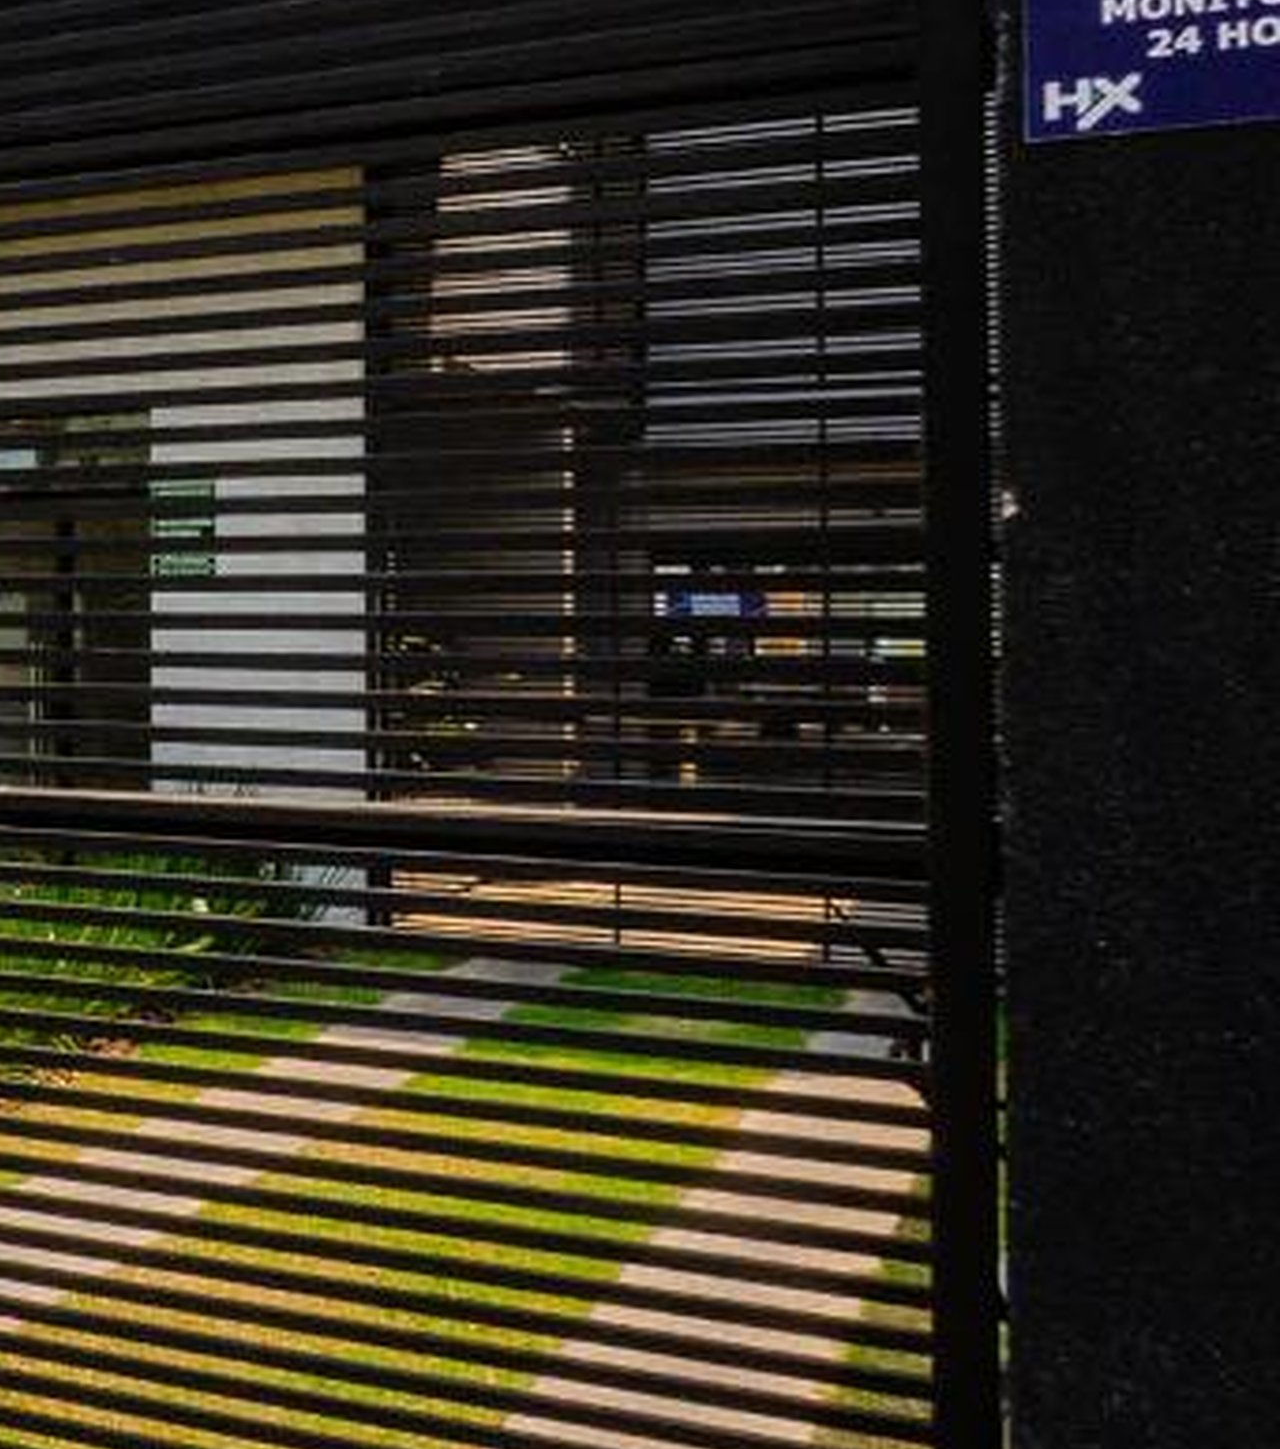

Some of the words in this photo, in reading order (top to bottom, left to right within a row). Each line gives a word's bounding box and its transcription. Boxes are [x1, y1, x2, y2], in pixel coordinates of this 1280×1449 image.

[1146, 25, 1203, 58] 24
[1218, 16, 1280, 50] HO
[1042, 72, 1143, 131] HX
